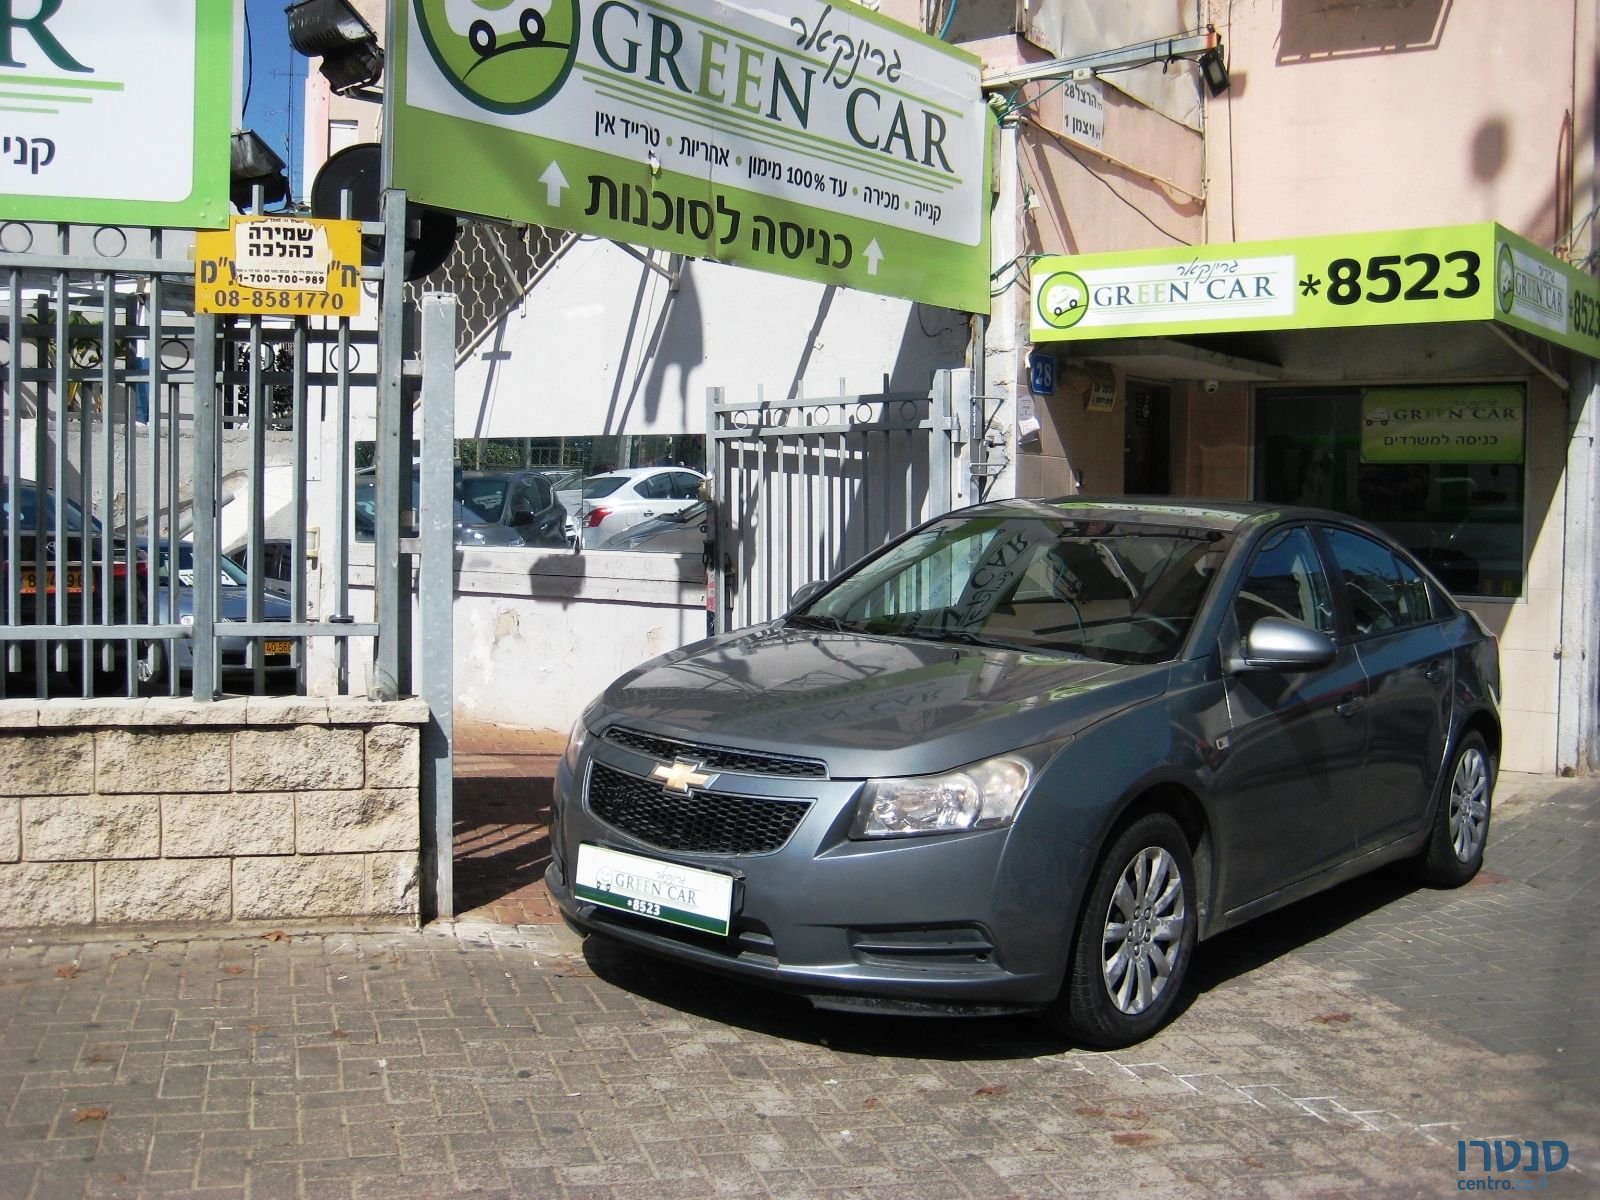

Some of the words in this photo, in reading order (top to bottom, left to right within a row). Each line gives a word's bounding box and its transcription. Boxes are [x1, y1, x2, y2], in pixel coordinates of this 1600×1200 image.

[790, 5, 902, 89] גרינקאר
[592, 1, 816, 129] GREEN
[846, 87, 954, 173] CAR
[595, 111, 616, 137] אין
[620, 118, 661, 147] טרייד
[679, 136, 730, 167] אחריות
[748, 155, 782, 181] מימון
[786, 166, 825, 192] 100%
[829, 176, 848, 198] עד
[863, 186, 900, 211] מכירה
[584, 175, 741, 244] לסוכנות
[914, 200, 942, 226] קנייה
[249, 226, 313, 241] שמירה
[751, 215, 853, 269] כניסה
[249, 242, 314, 258] כהלכה
[238, 274, 325, 284] 1-700-700-989
[1094, 281, 1190, 307] GREEN
[1206, 276, 1275, 300] CAR
[214, 290, 344, 310] 08-8581770
[1545, 286, 1563, 314] CAR
[1035, 362, 1052, 387] 28
[1472, 407, 1515, 420] CAR
[1384, 433, 1450, 446] למשרדים
[1456, 434, 1498, 446] כניסה
[615, 873, 663, 897] GREEN
[667, 886, 696, 905] CAR
